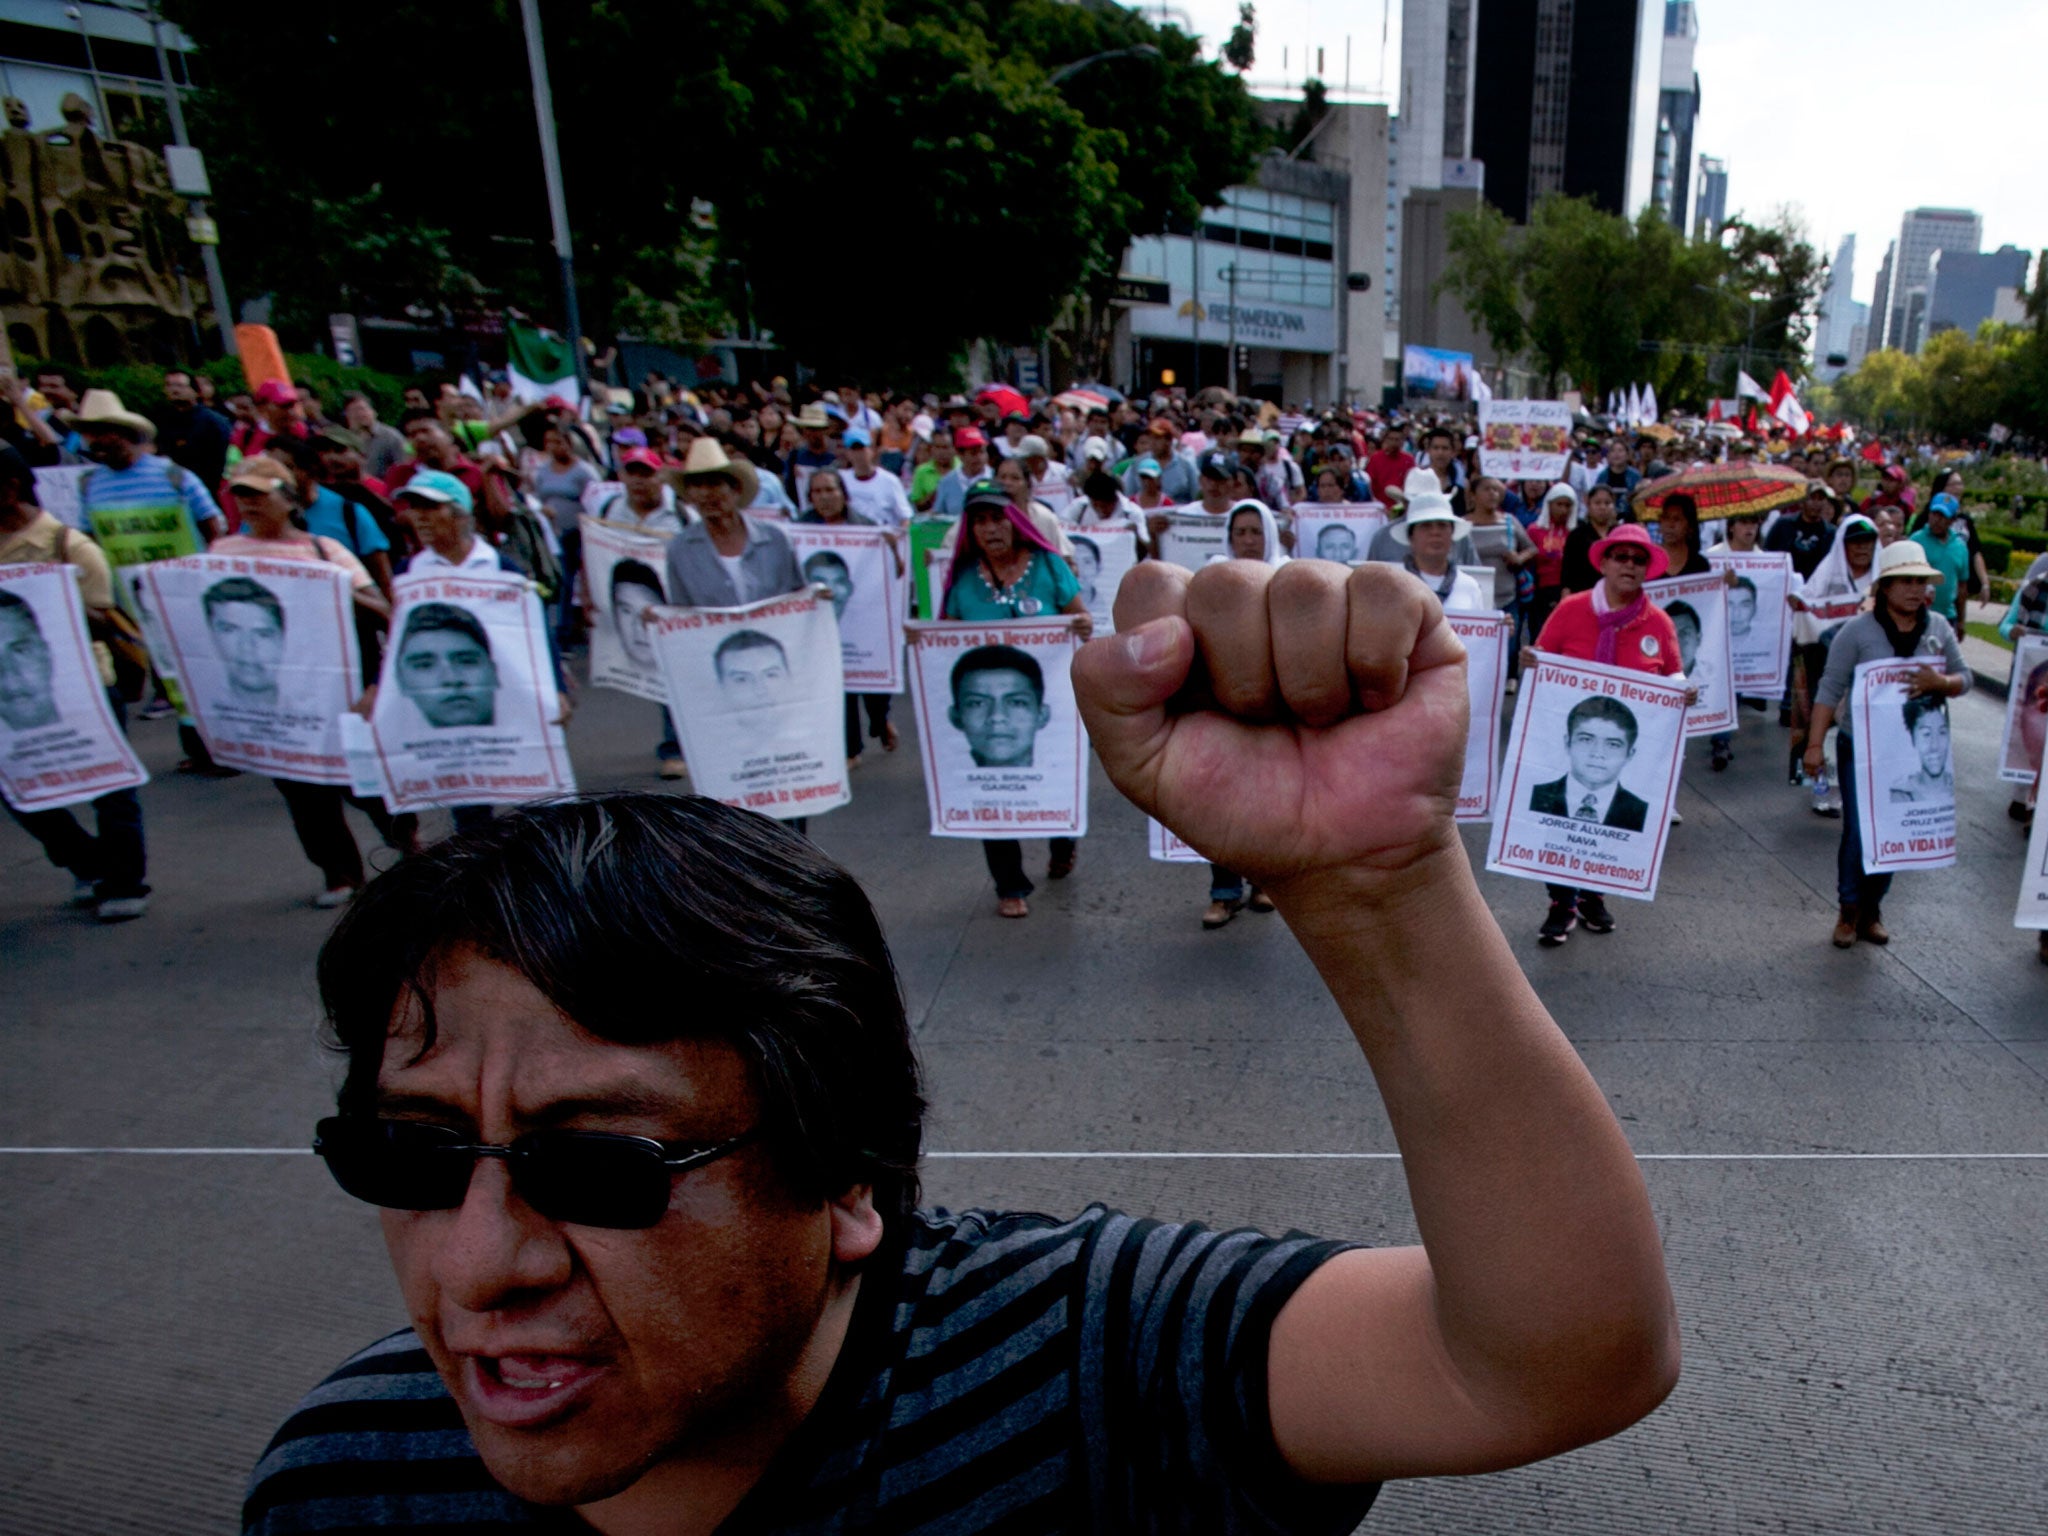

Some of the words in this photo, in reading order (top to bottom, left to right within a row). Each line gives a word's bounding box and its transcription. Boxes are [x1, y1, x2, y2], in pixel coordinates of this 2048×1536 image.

[920, 632, 960, 650] ¡Vivo
[964, 634, 980, 646] se
[984, 631, 999, 646] lo
[1003, 629, 1070, 646] llevaron!
[1538, 667, 1578, 688] ¡Vivo
[1581, 677, 1598, 692] se
[1602, 678, 1617, 695] lo
[1620, 682, 1685, 710] llevaron!
[1002, 773, 1044, 782] BRUNO
[973, 807, 1000, 822] VIDA
[1901, 818, 1931, 827] CRUZ
[1538, 816, 1578, 832] JORGE
[1579, 823, 1632, 842] ÁLVAREZ
[1566, 834, 1598, 848] NAVA
[1880, 841, 1905, 857] ¡Con
[1908, 837, 1937, 853] VIDA
[1544, 842, 1573, 854] EDAD
[1590, 849, 1619, 863] AÑOS
[1507, 843, 1534, 861] ¡Con
[1538, 849, 1567, 868] VIDA
[1569, 855, 1581, 870] lo
[1583, 860, 1646, 883] queremos!
